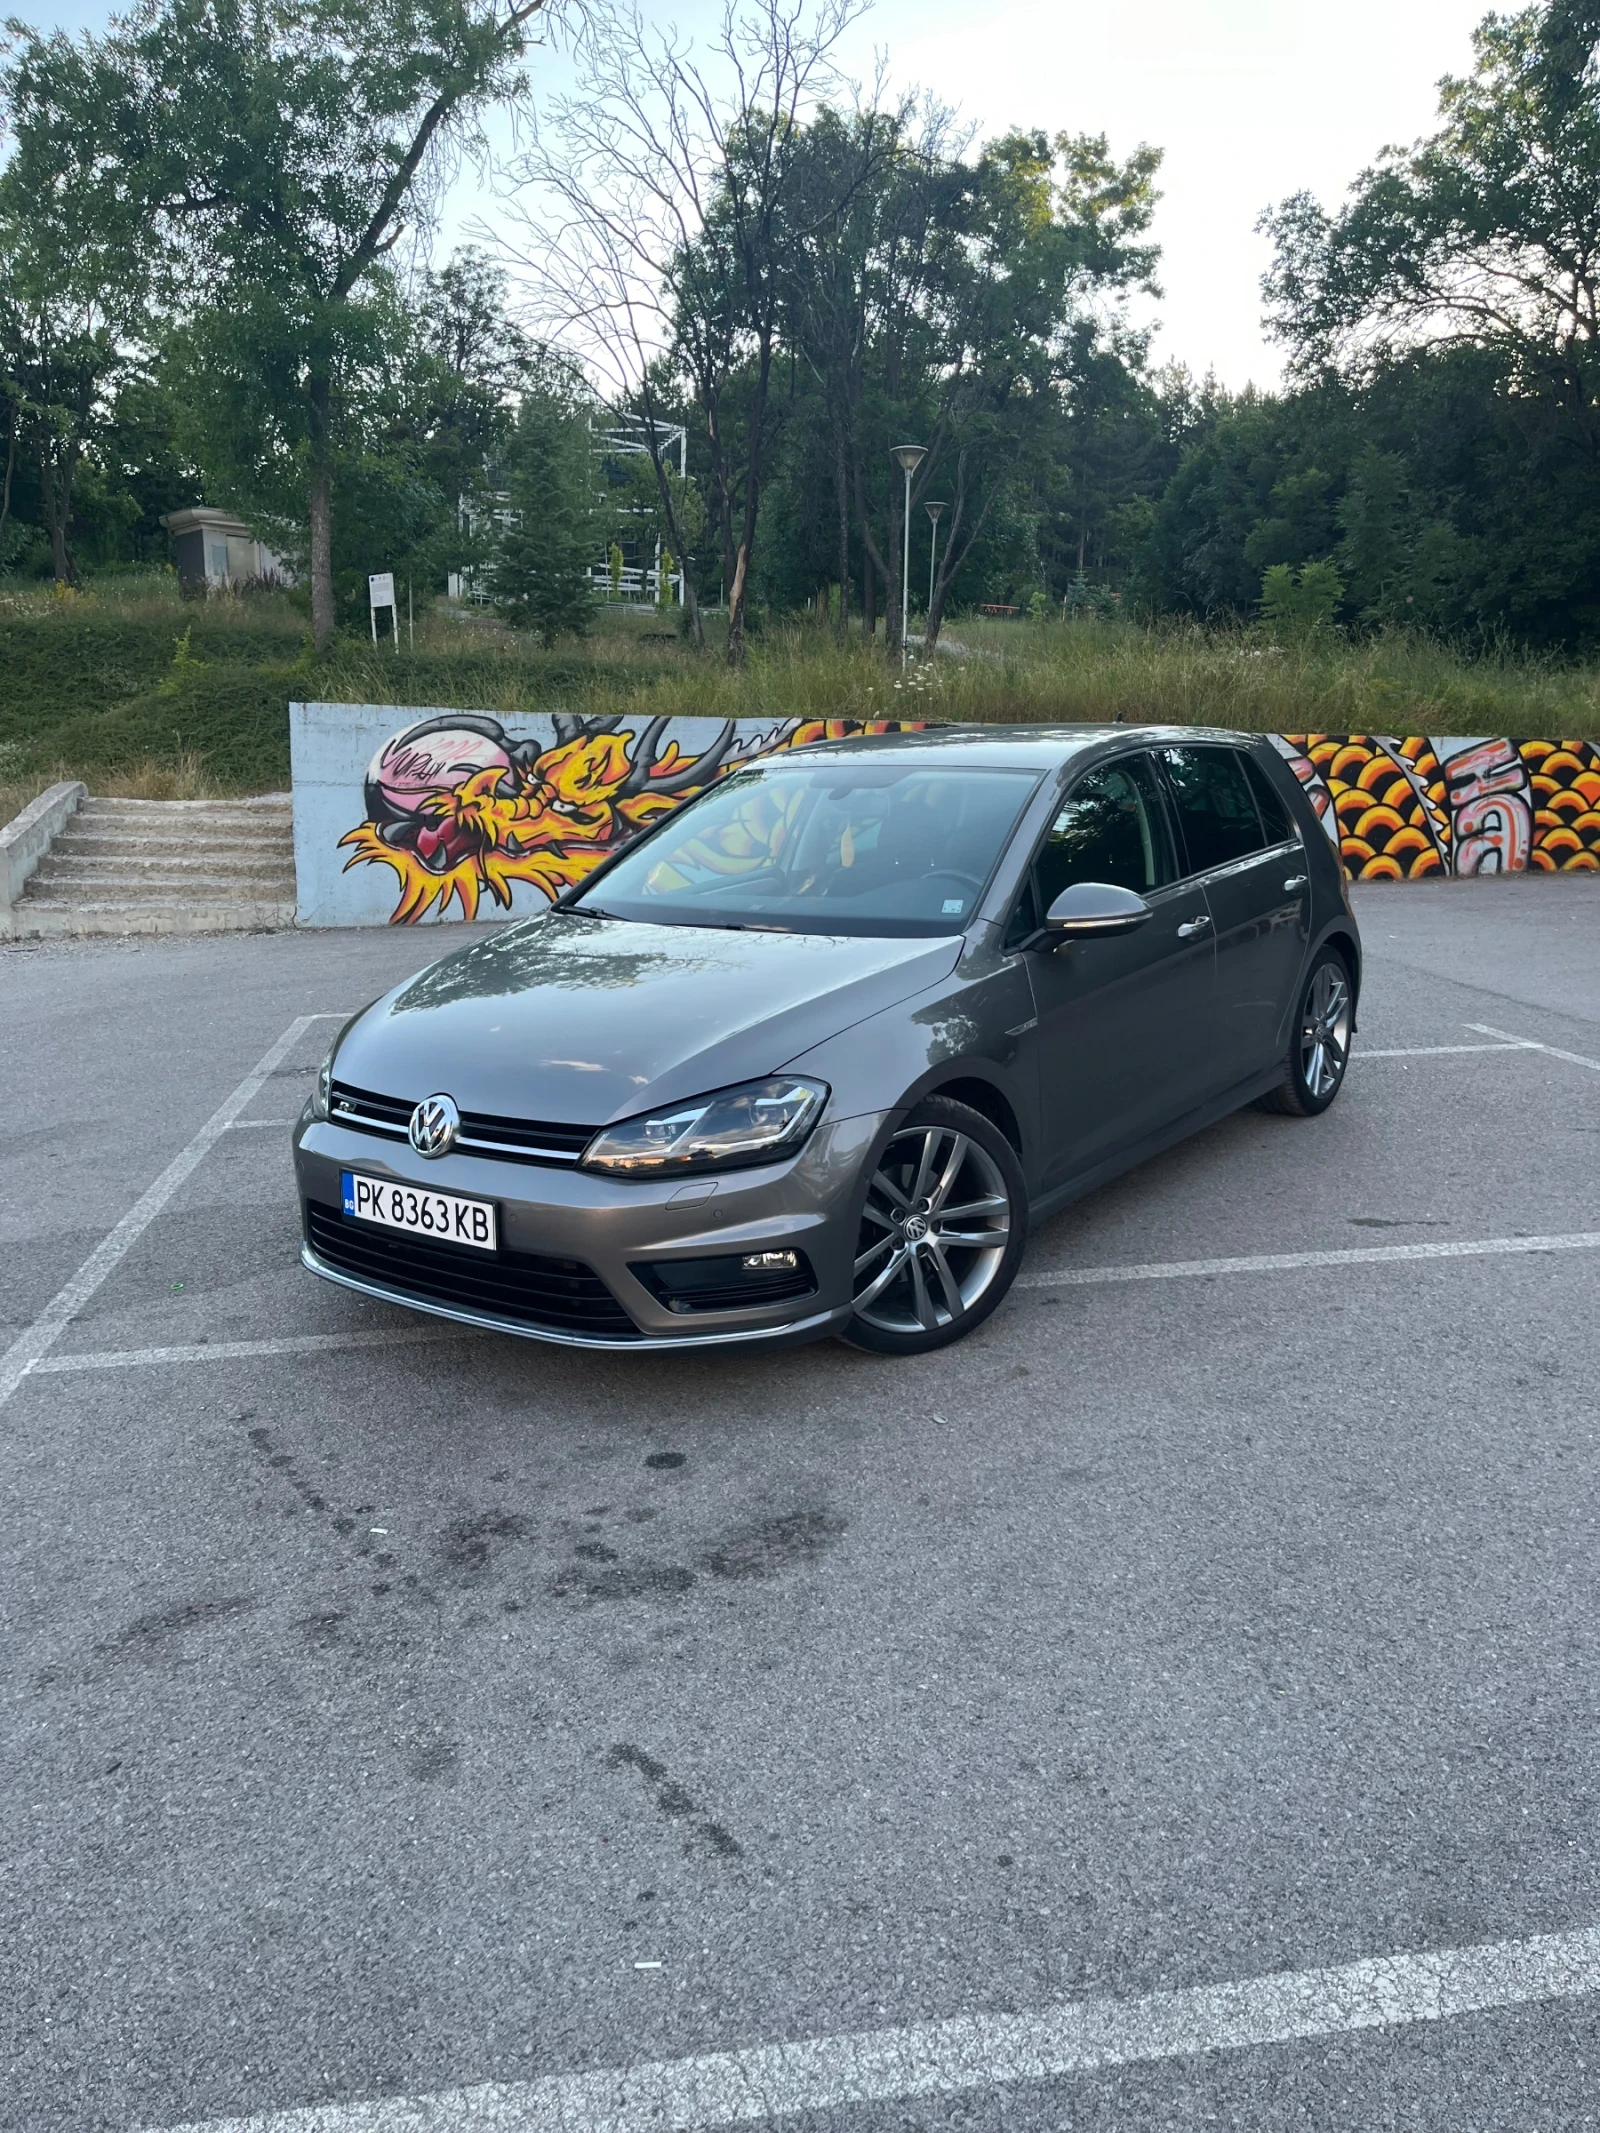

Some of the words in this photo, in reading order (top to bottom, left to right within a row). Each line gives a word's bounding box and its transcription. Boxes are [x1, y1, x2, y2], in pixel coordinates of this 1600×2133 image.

[344, 1198, 354, 1210] BG
[356, 1180, 386, 1219] PK
[391, 1189, 450, 1233] 8363
[454, 1203, 489, 1242] KB
